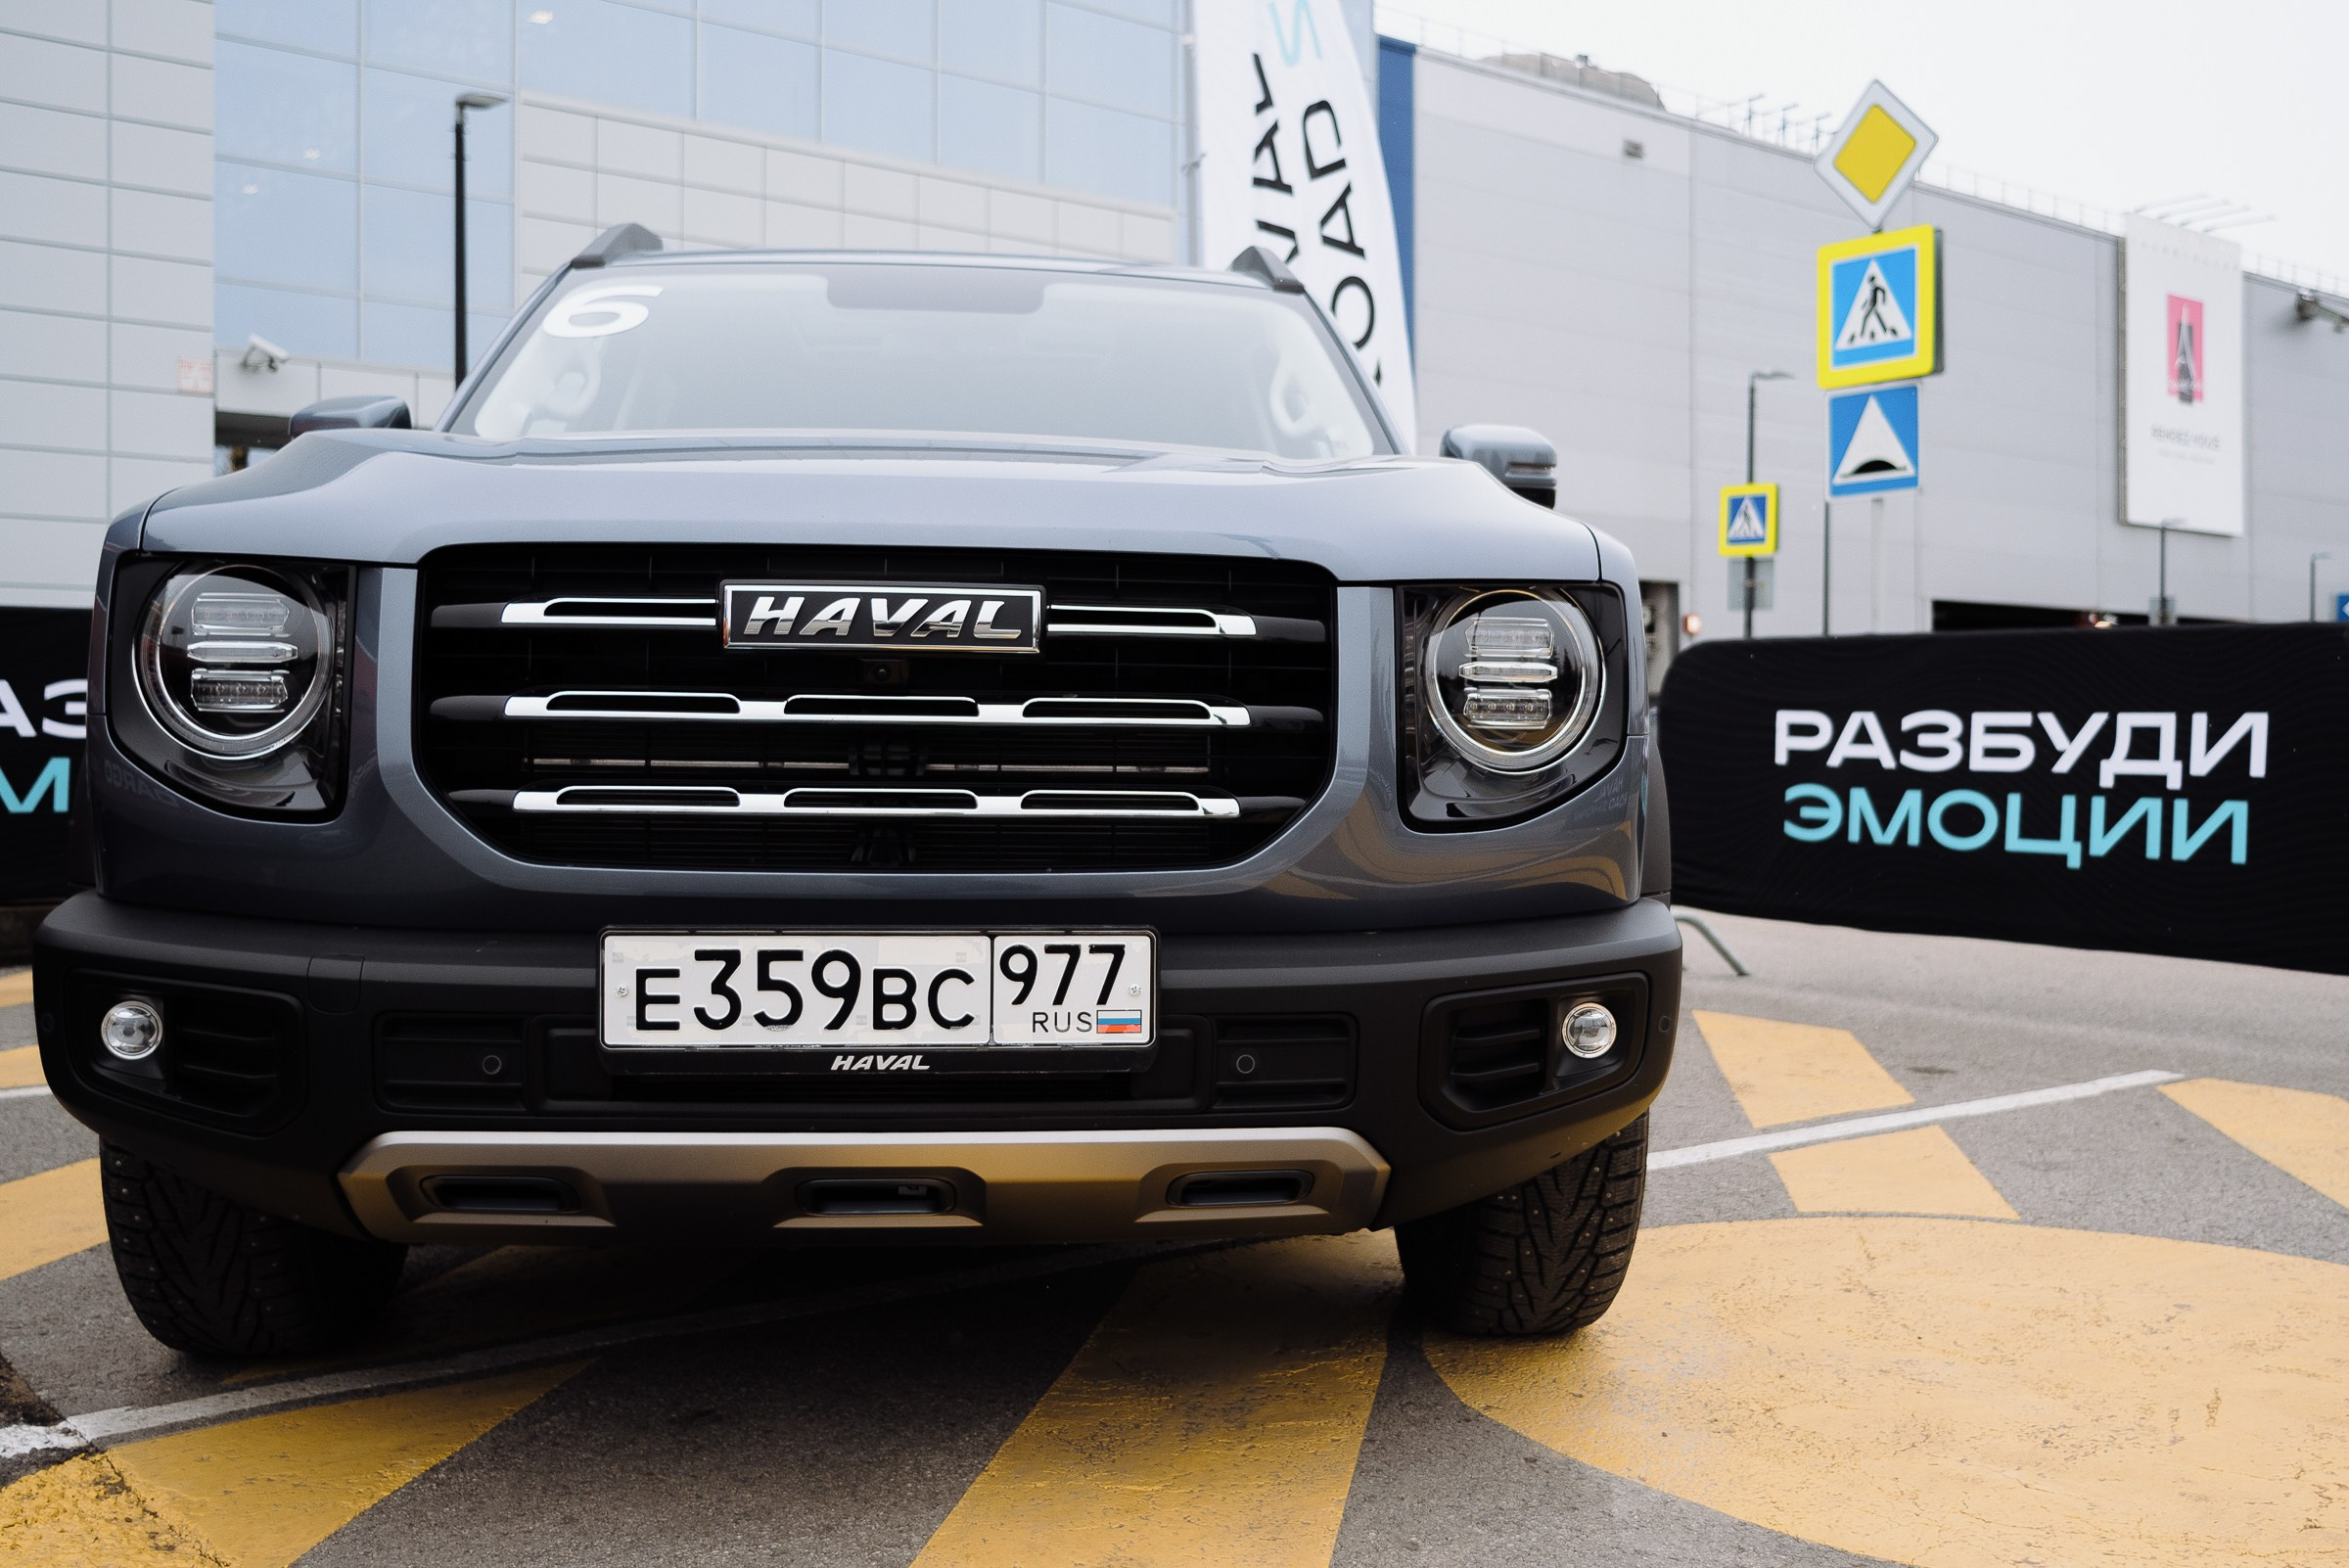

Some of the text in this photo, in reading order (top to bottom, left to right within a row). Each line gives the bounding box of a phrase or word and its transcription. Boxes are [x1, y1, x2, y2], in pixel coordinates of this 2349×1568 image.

[1303, 100, 1382, 386] OAD
[542, 284, 664, 339] 6
[743, 596, 1022, 639] HAVAL
[1773, 709, 2269, 790] РАЗБУДИ
[1783, 783, 2249, 869] ЭМОЦИИ
[999, 944, 1126, 1006] 977
[1032, 1011, 1092, 1034] RUS
[830, 1054, 931, 1071] HAVAL
